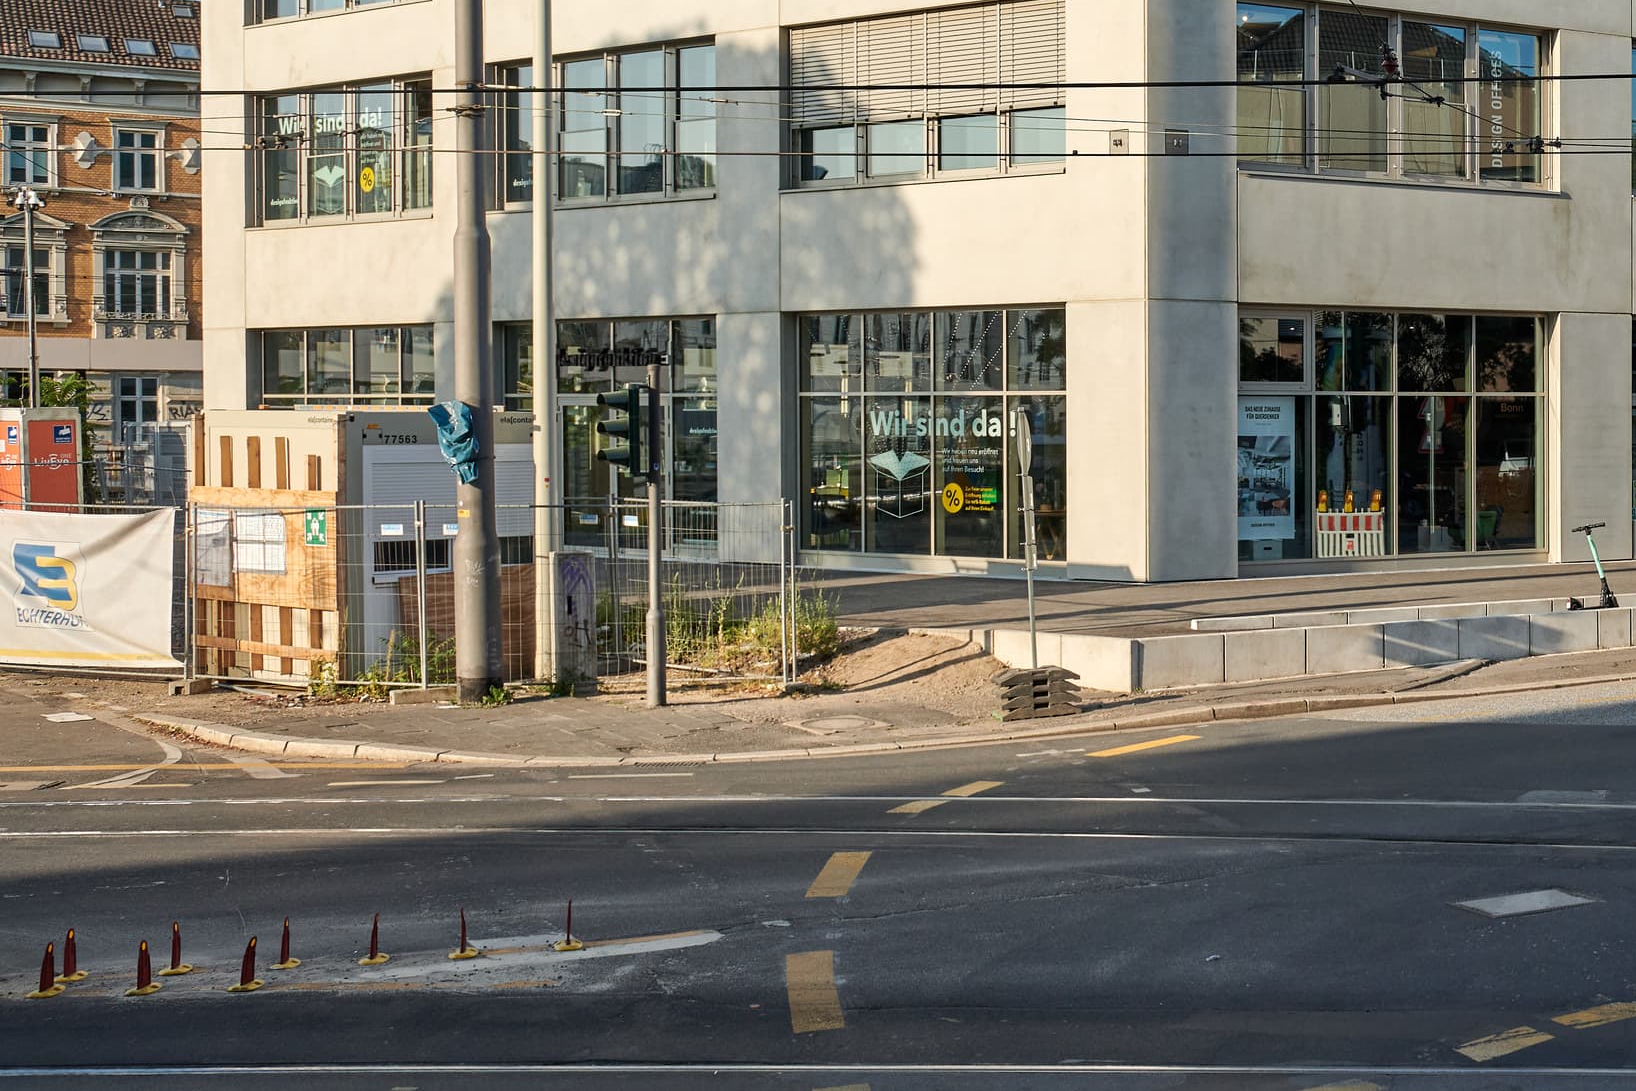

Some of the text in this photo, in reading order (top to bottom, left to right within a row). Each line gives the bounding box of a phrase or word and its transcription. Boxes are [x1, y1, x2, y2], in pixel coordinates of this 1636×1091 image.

[316, 109, 345, 133] sind
[359, 106, 382, 128] da!
[870, 410, 909, 437] Wir
[916, 410, 964, 437] sind
[384, 434, 418, 445] 77563
[17, 607, 89, 628] ECHTERHO
